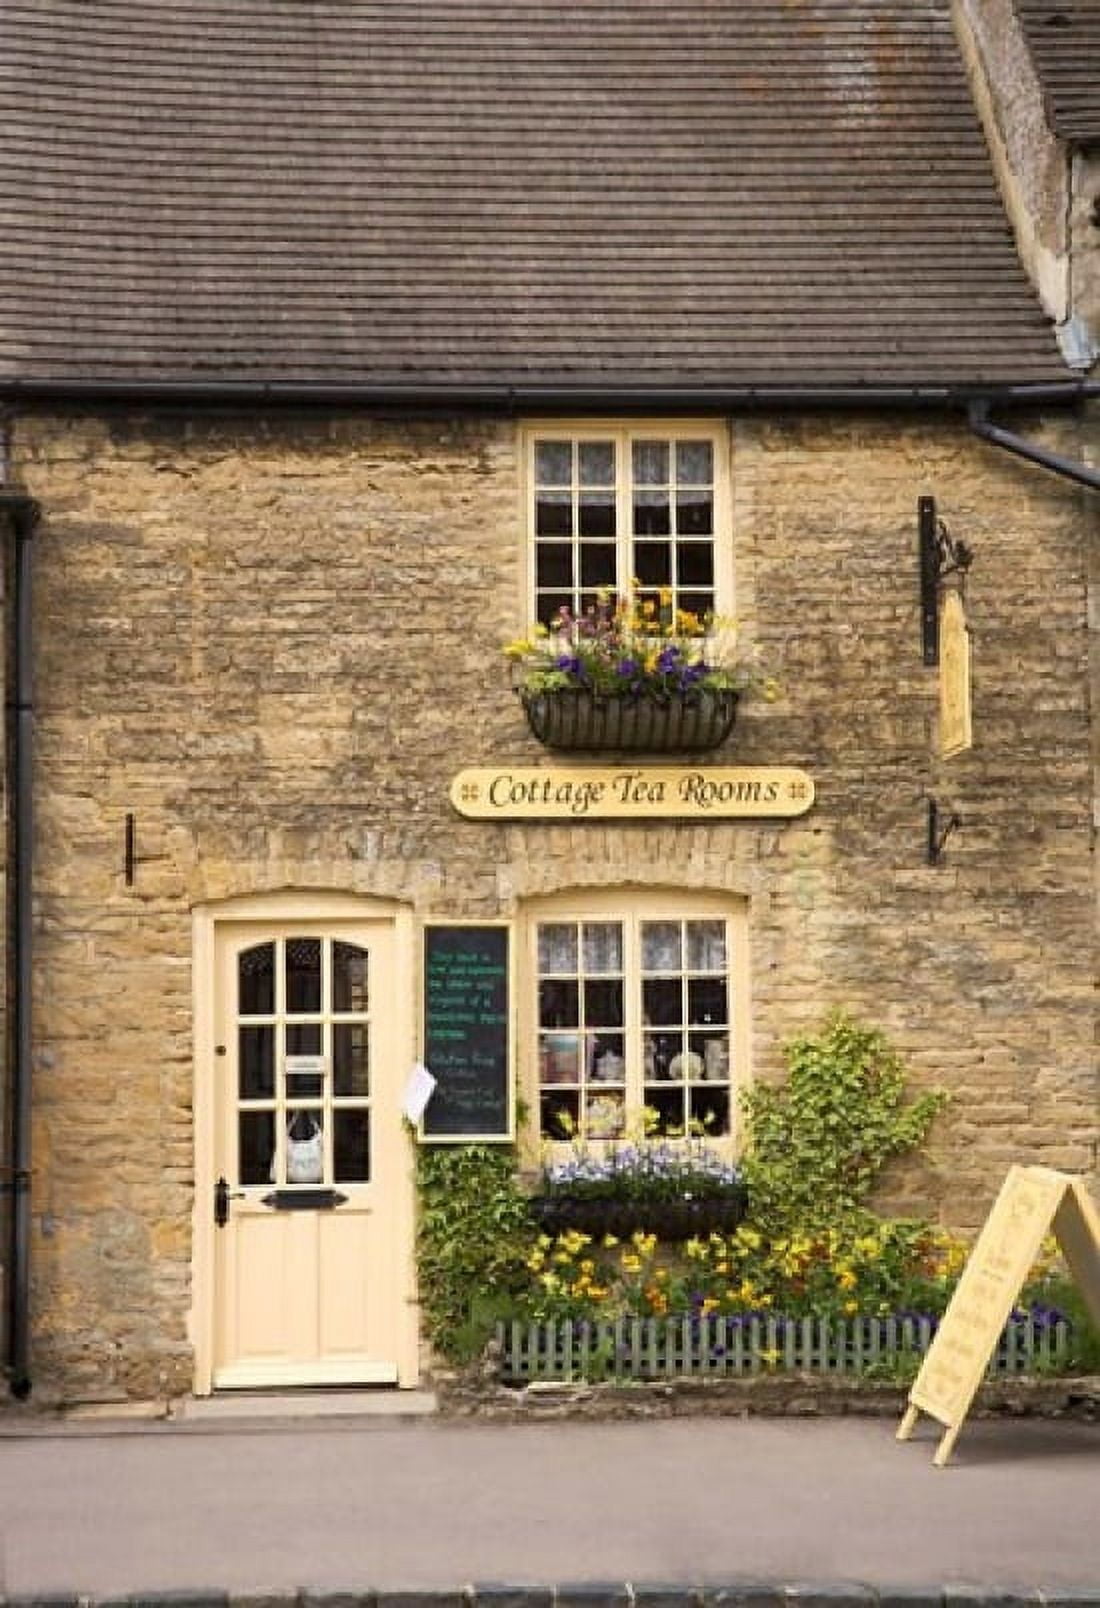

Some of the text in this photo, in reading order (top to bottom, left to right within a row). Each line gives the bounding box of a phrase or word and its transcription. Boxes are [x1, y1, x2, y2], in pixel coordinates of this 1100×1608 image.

[489, 771, 779, 812] Cottage Tea Rooms
